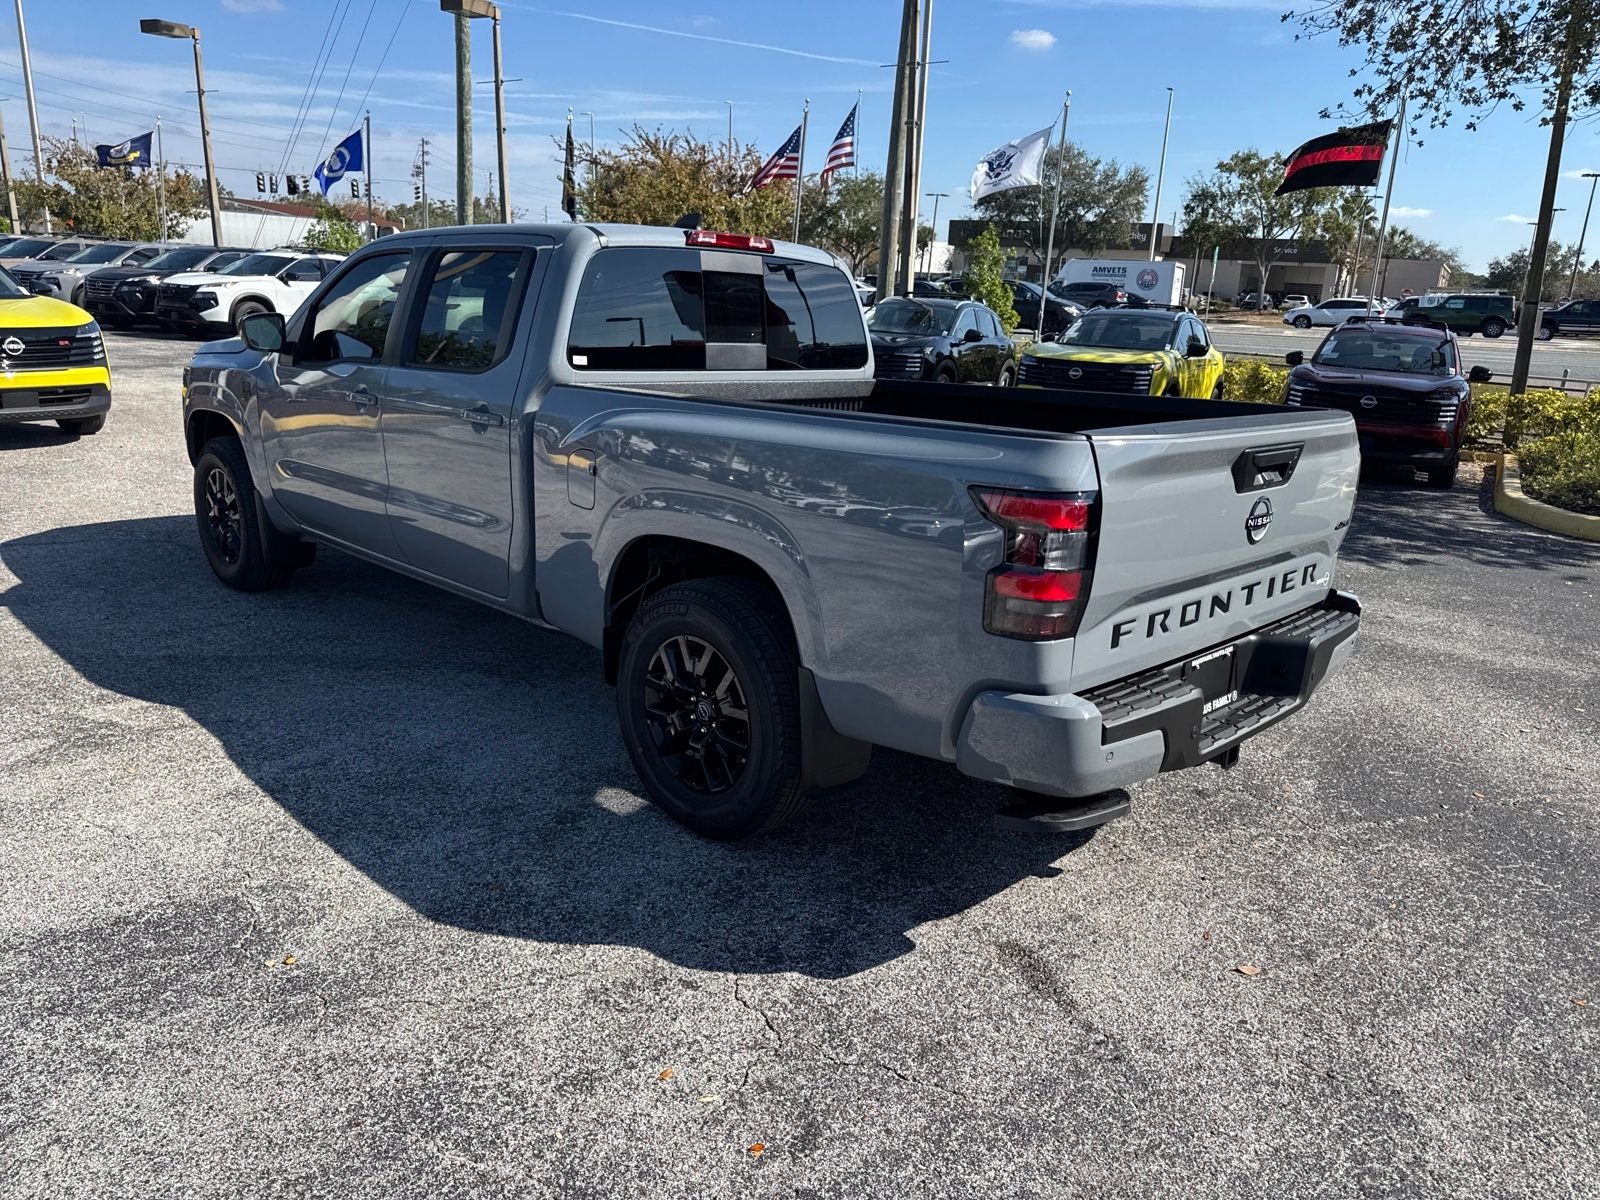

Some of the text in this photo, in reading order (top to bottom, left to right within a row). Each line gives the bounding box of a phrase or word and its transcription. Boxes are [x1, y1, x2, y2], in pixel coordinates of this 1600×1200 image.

[1092, 266, 1127, 274] AMVETS
[1110, 563, 1317, 649] FRONTIER
[1212, 692, 1232, 710] FAMILY
